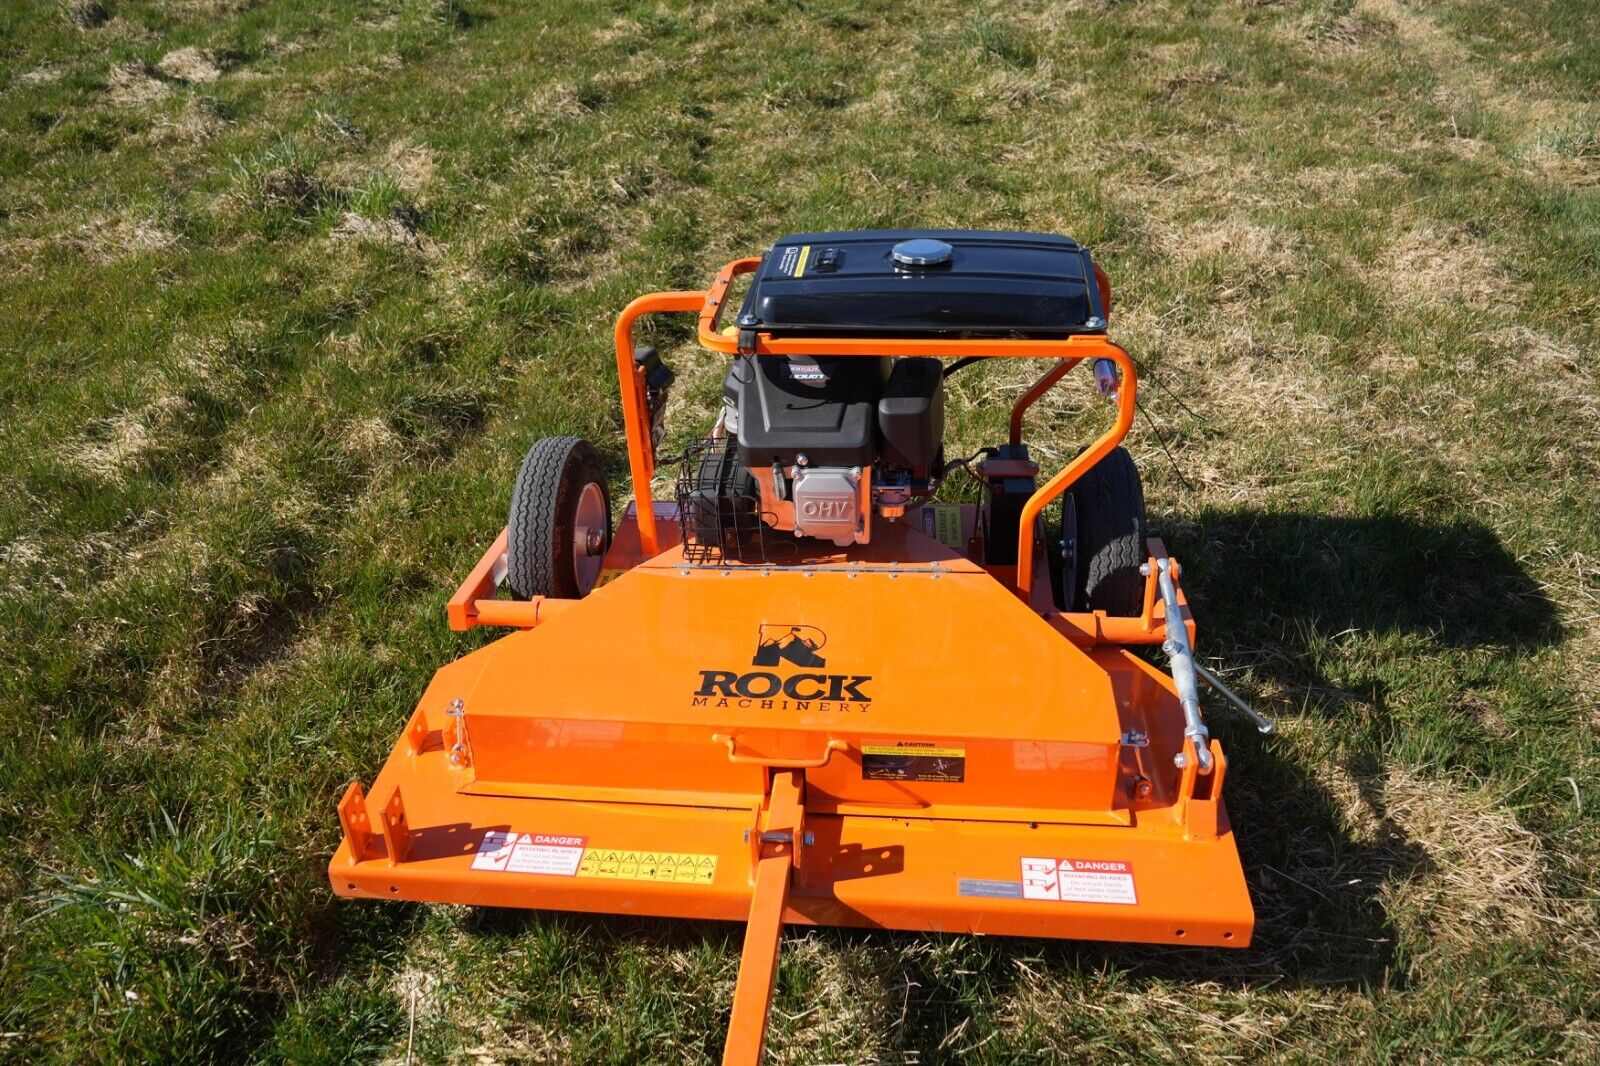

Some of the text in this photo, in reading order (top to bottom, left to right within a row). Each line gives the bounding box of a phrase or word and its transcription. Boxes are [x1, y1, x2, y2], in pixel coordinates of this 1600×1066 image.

[802, 501, 850, 517] OHV
[694, 670, 872, 702] ROCK
[692, 697, 872, 713] MACHINERY
[534, 835, 583, 845] DANGER
[1075, 861, 1127, 871] DANGER
